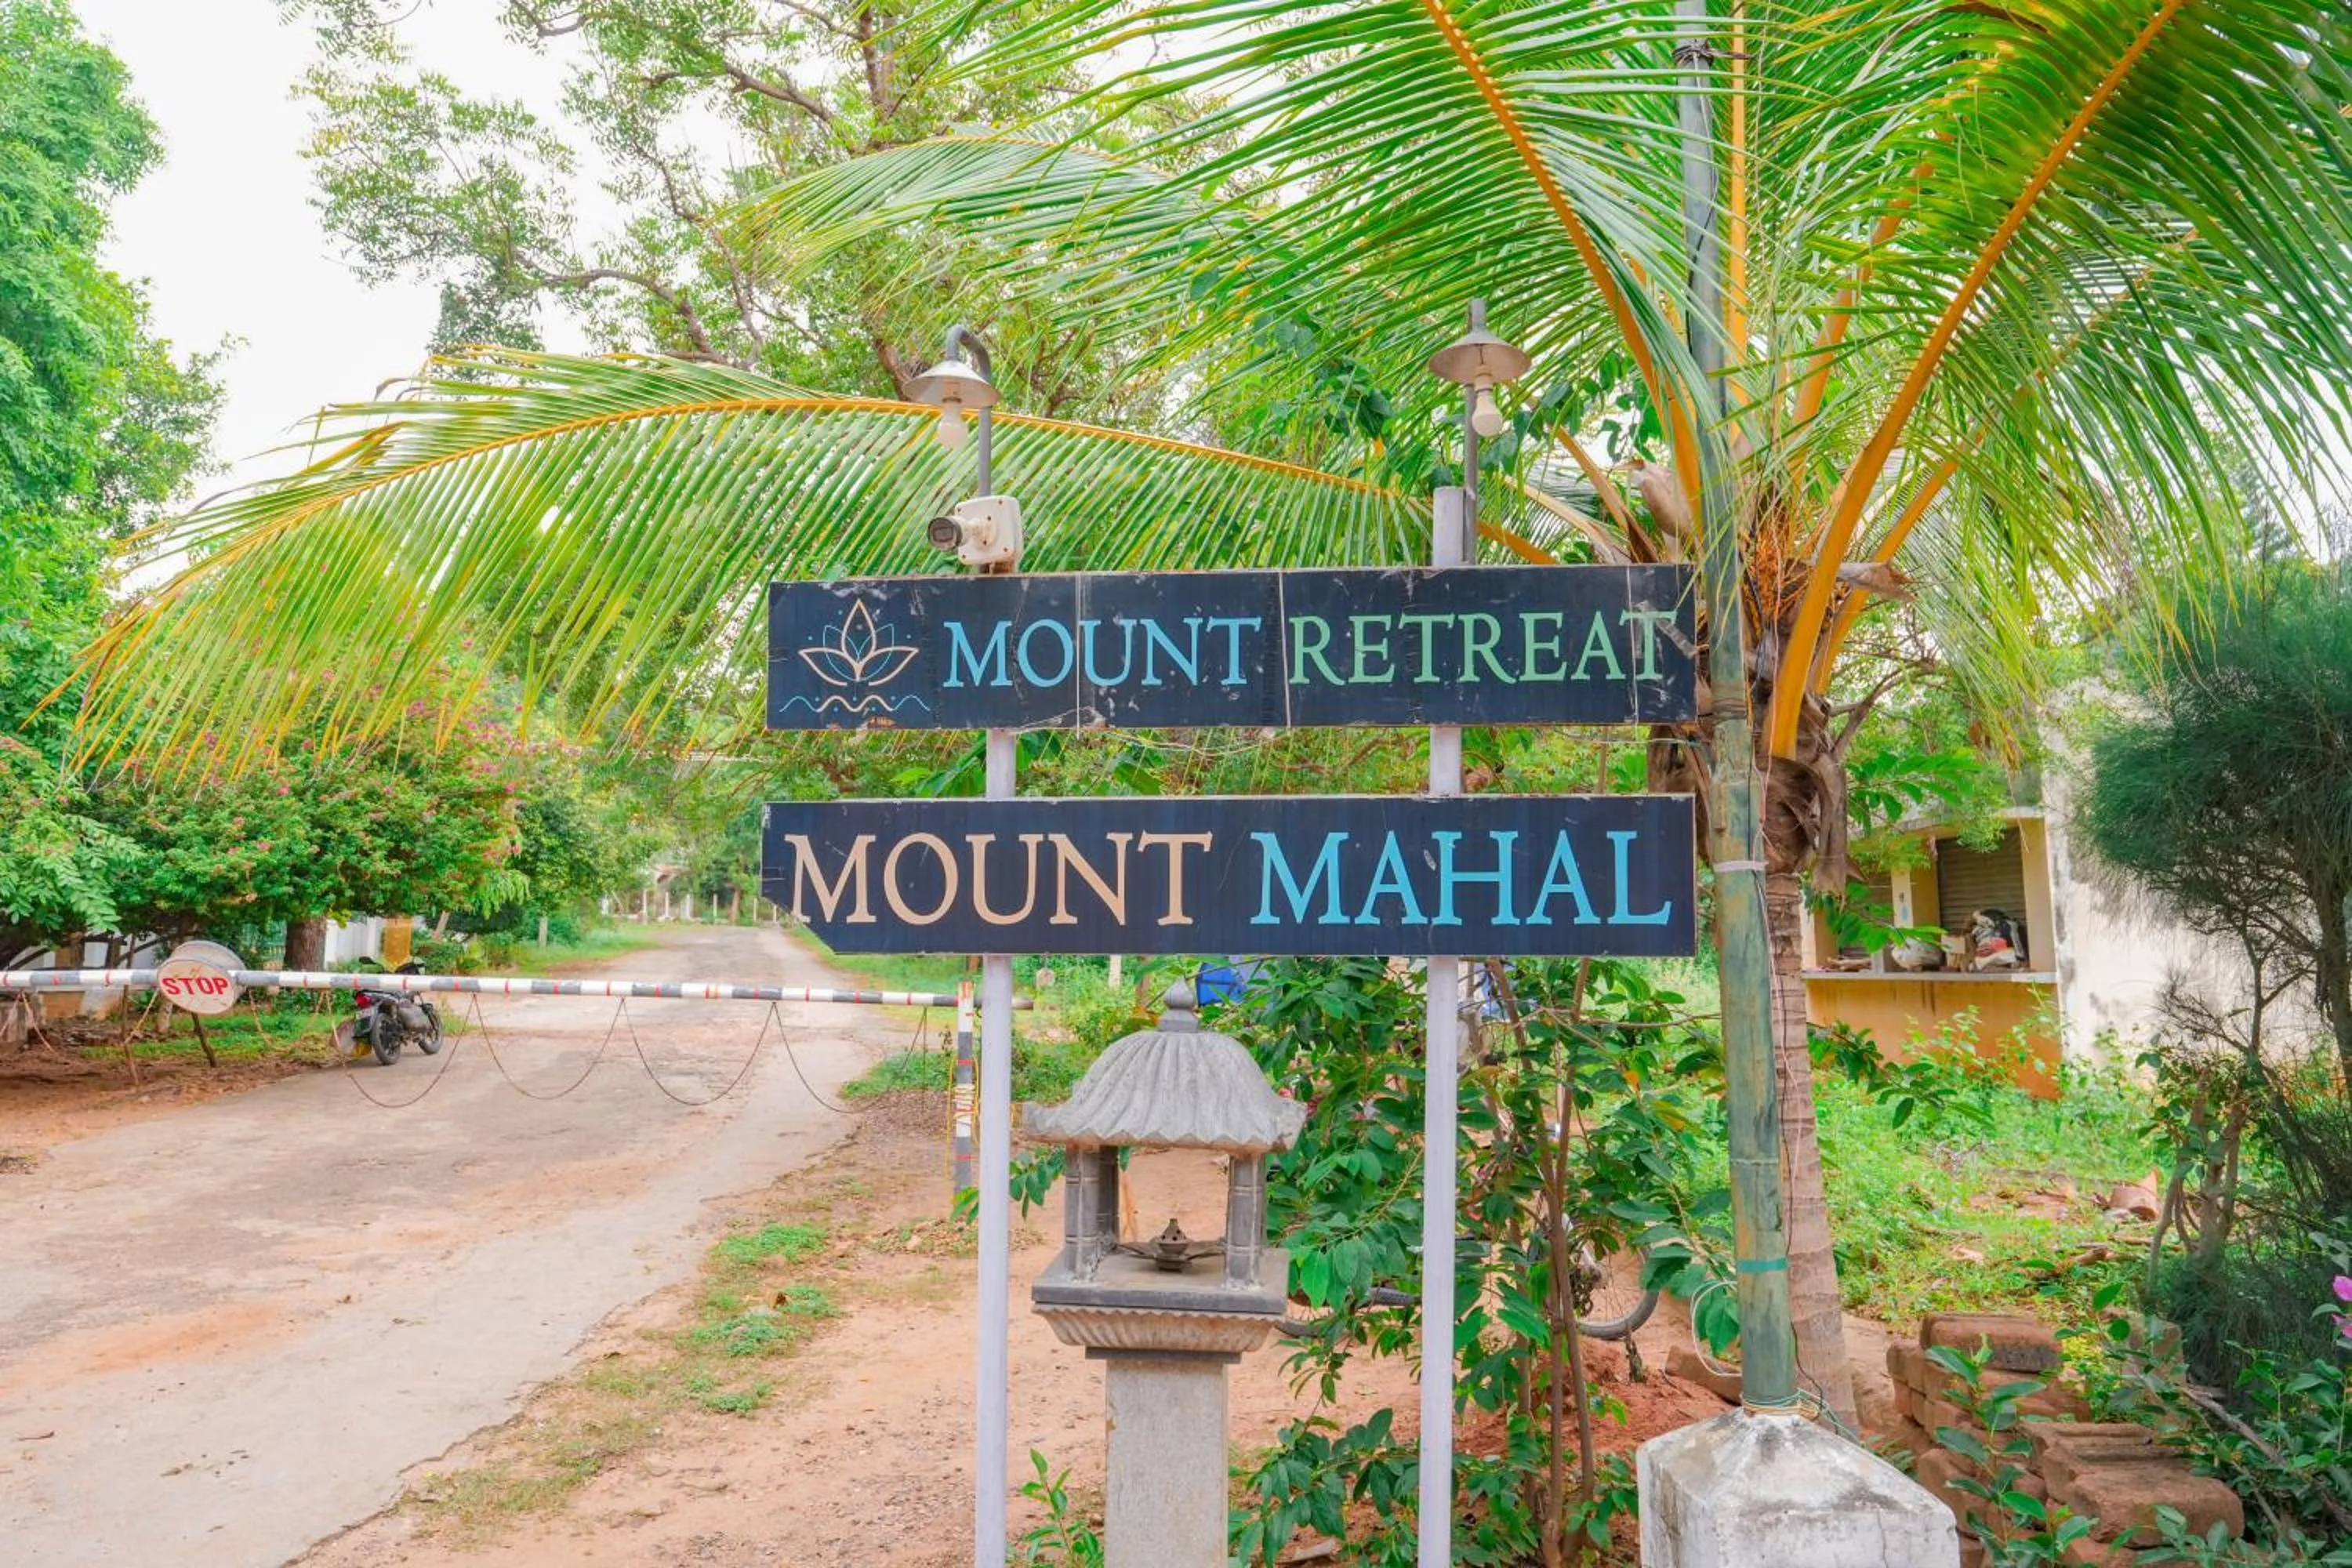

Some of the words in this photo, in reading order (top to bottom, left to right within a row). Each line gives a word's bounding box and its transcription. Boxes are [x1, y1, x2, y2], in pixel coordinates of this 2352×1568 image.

[943, 618, 1261, 688] MOUNT
[1289, 611, 1678, 686] RETREAT
[785, 830, 1213, 926] MOUNT
[1250, 829, 1671, 926] MAHAL
[162, 978, 228, 995] STOP
